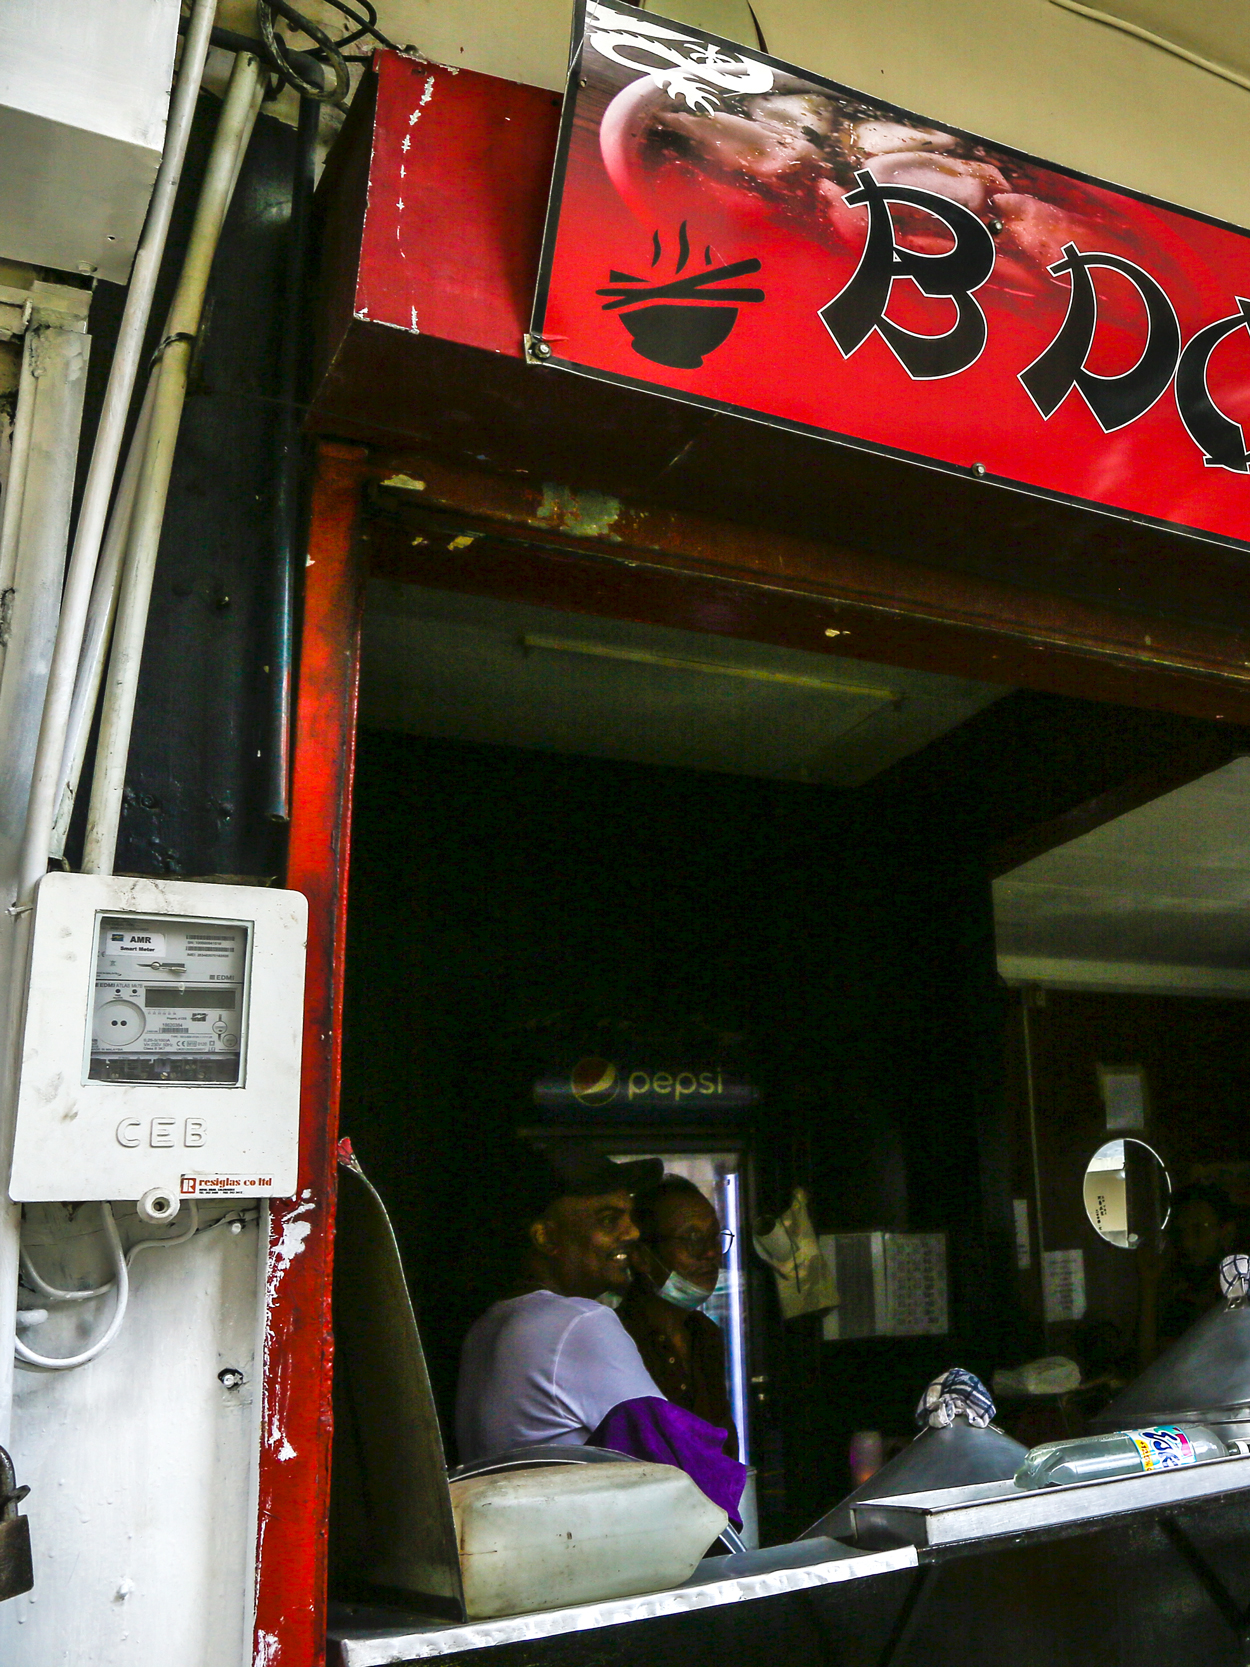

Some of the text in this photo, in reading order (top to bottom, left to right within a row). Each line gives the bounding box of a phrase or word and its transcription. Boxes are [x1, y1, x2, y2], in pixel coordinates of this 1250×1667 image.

[628, 1067, 724, 1101] pepsi
[115, 1116, 208, 1148] CEB
[199, 1177, 241, 1188] resiglas
[258, 1177, 272, 1186] ltd
